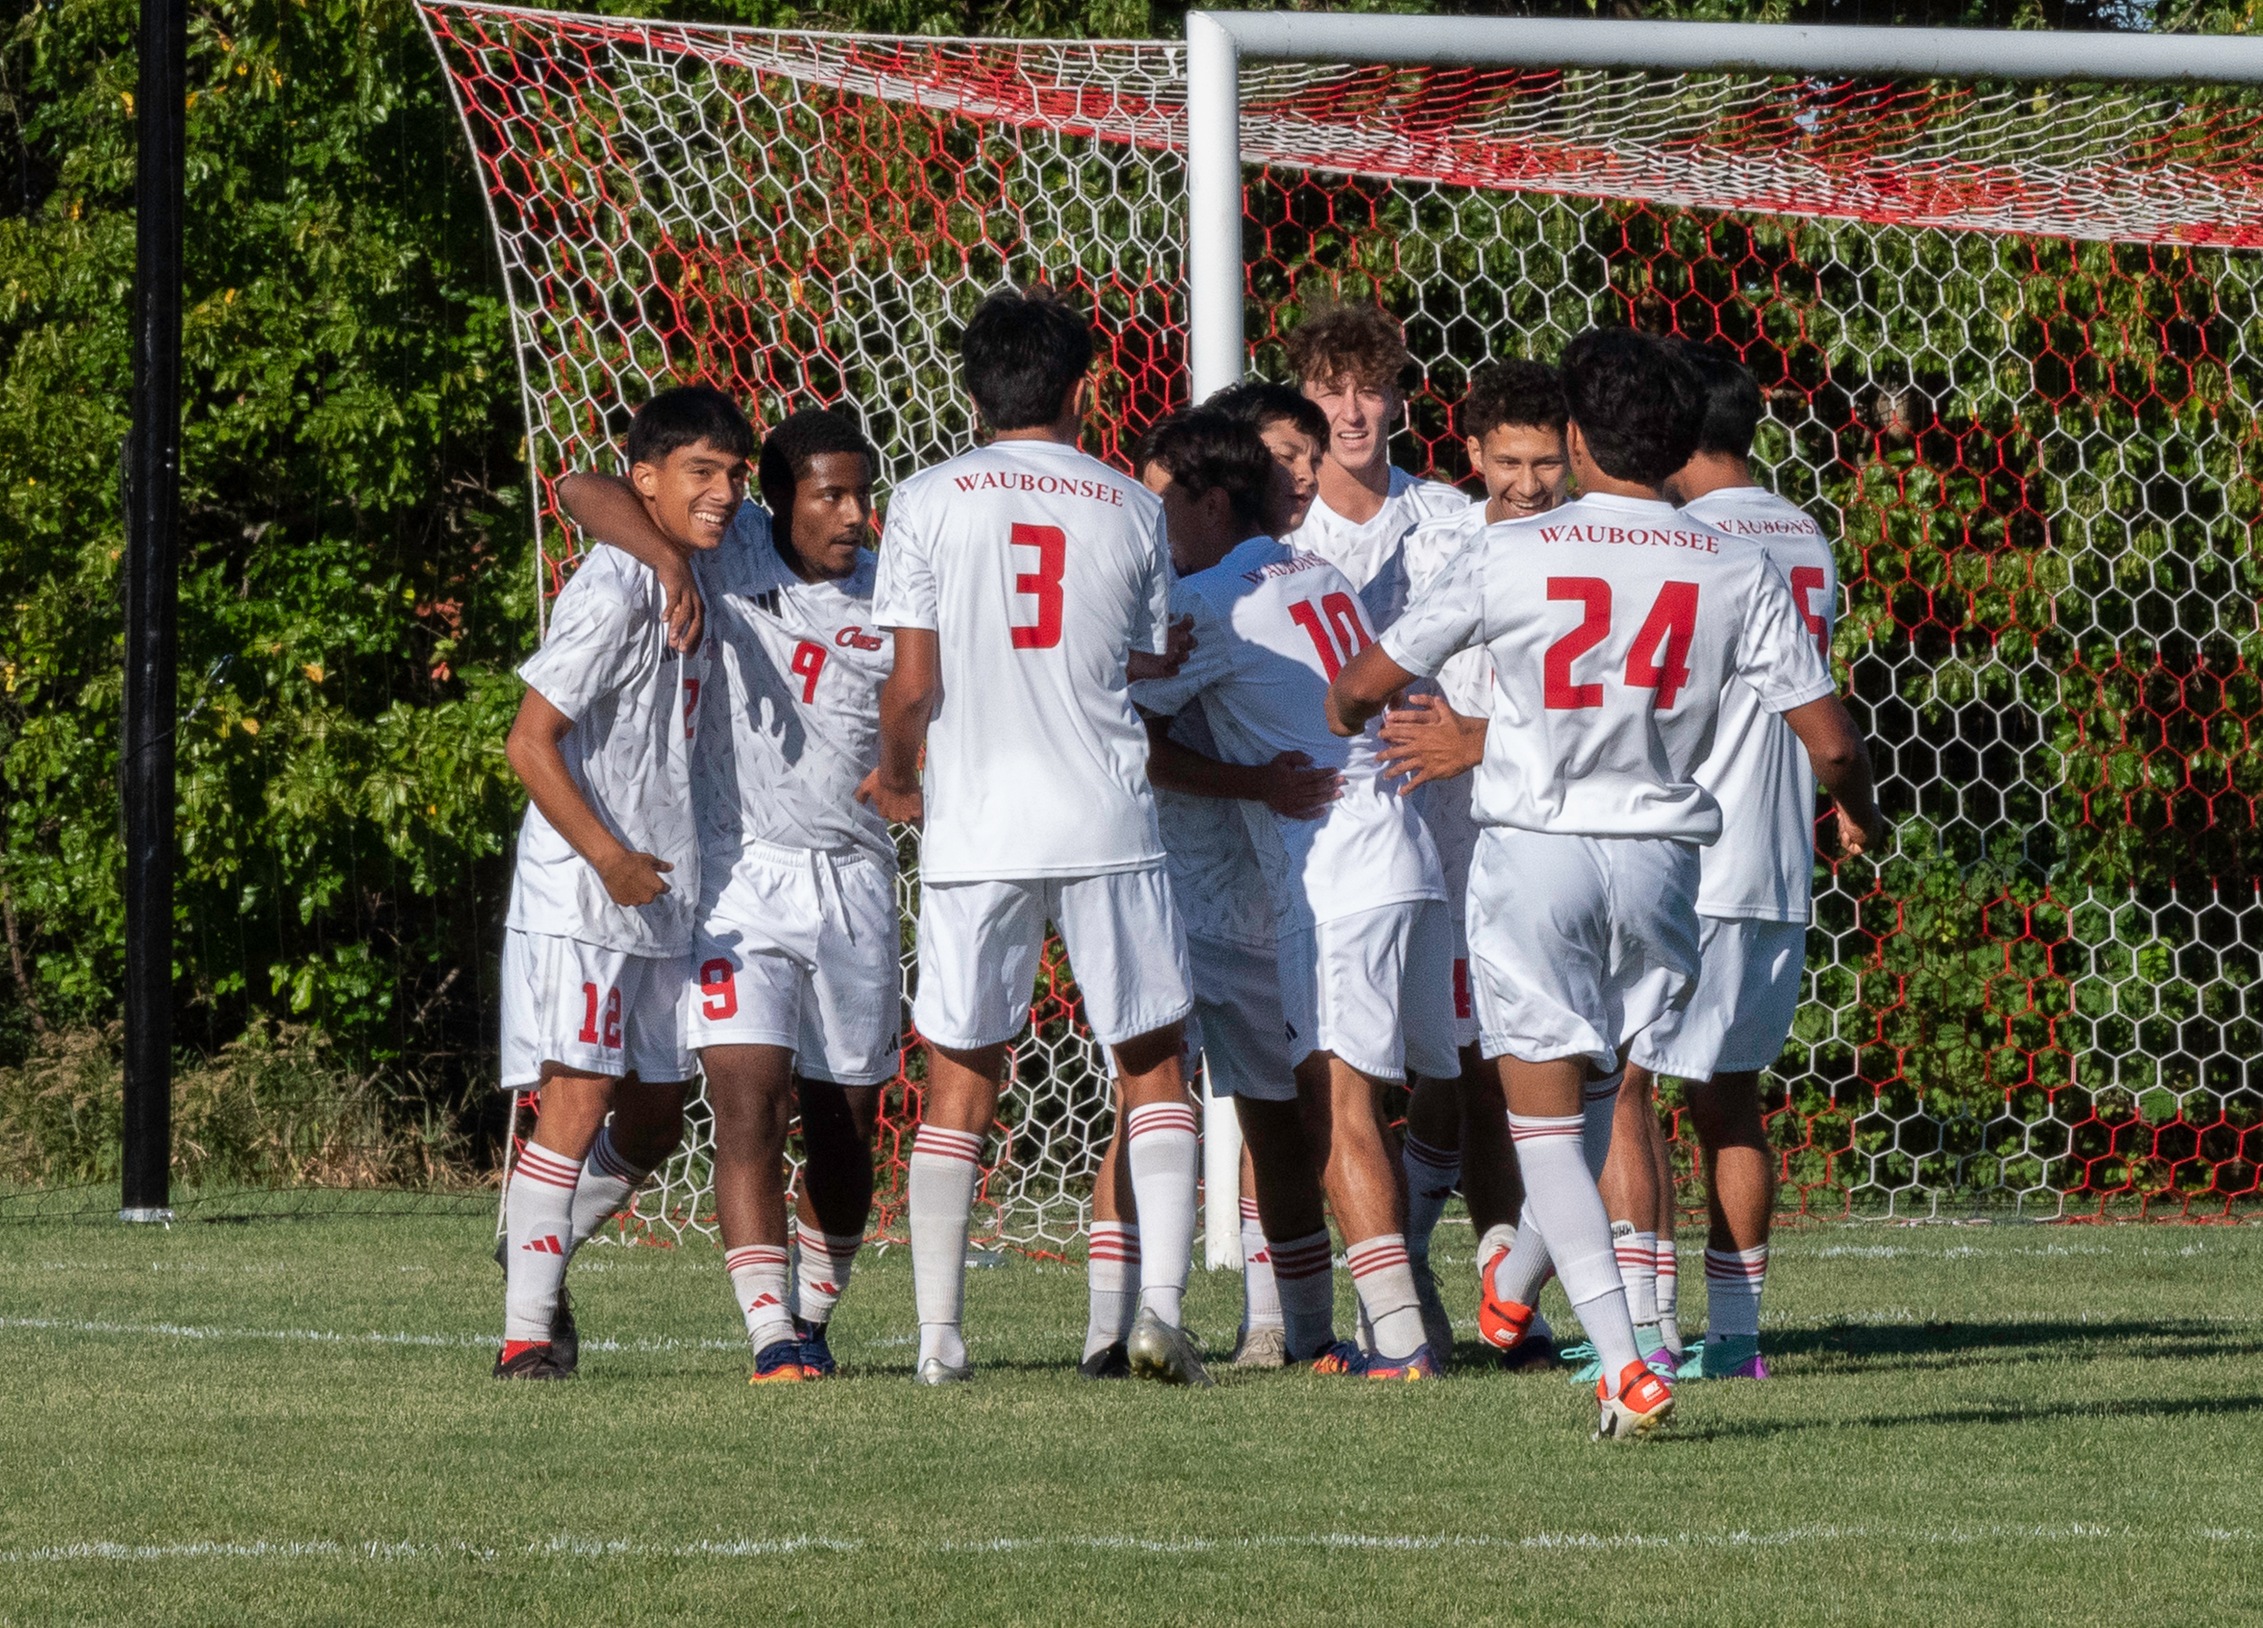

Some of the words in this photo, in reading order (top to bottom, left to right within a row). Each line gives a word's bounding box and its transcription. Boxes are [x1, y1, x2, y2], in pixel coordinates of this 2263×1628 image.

[953, 471, 1123, 508] WAUBONSEE
[1539, 524, 1720, 555] WAUBONSEE
[1010, 522, 1066, 649] 3
[1287, 591, 1374, 686] 10
[1544, 576, 1699, 710] 24
[791, 640, 828, 705] 9
[578, 981, 622, 1049] 12
[700, 957, 738, 1021] 9
